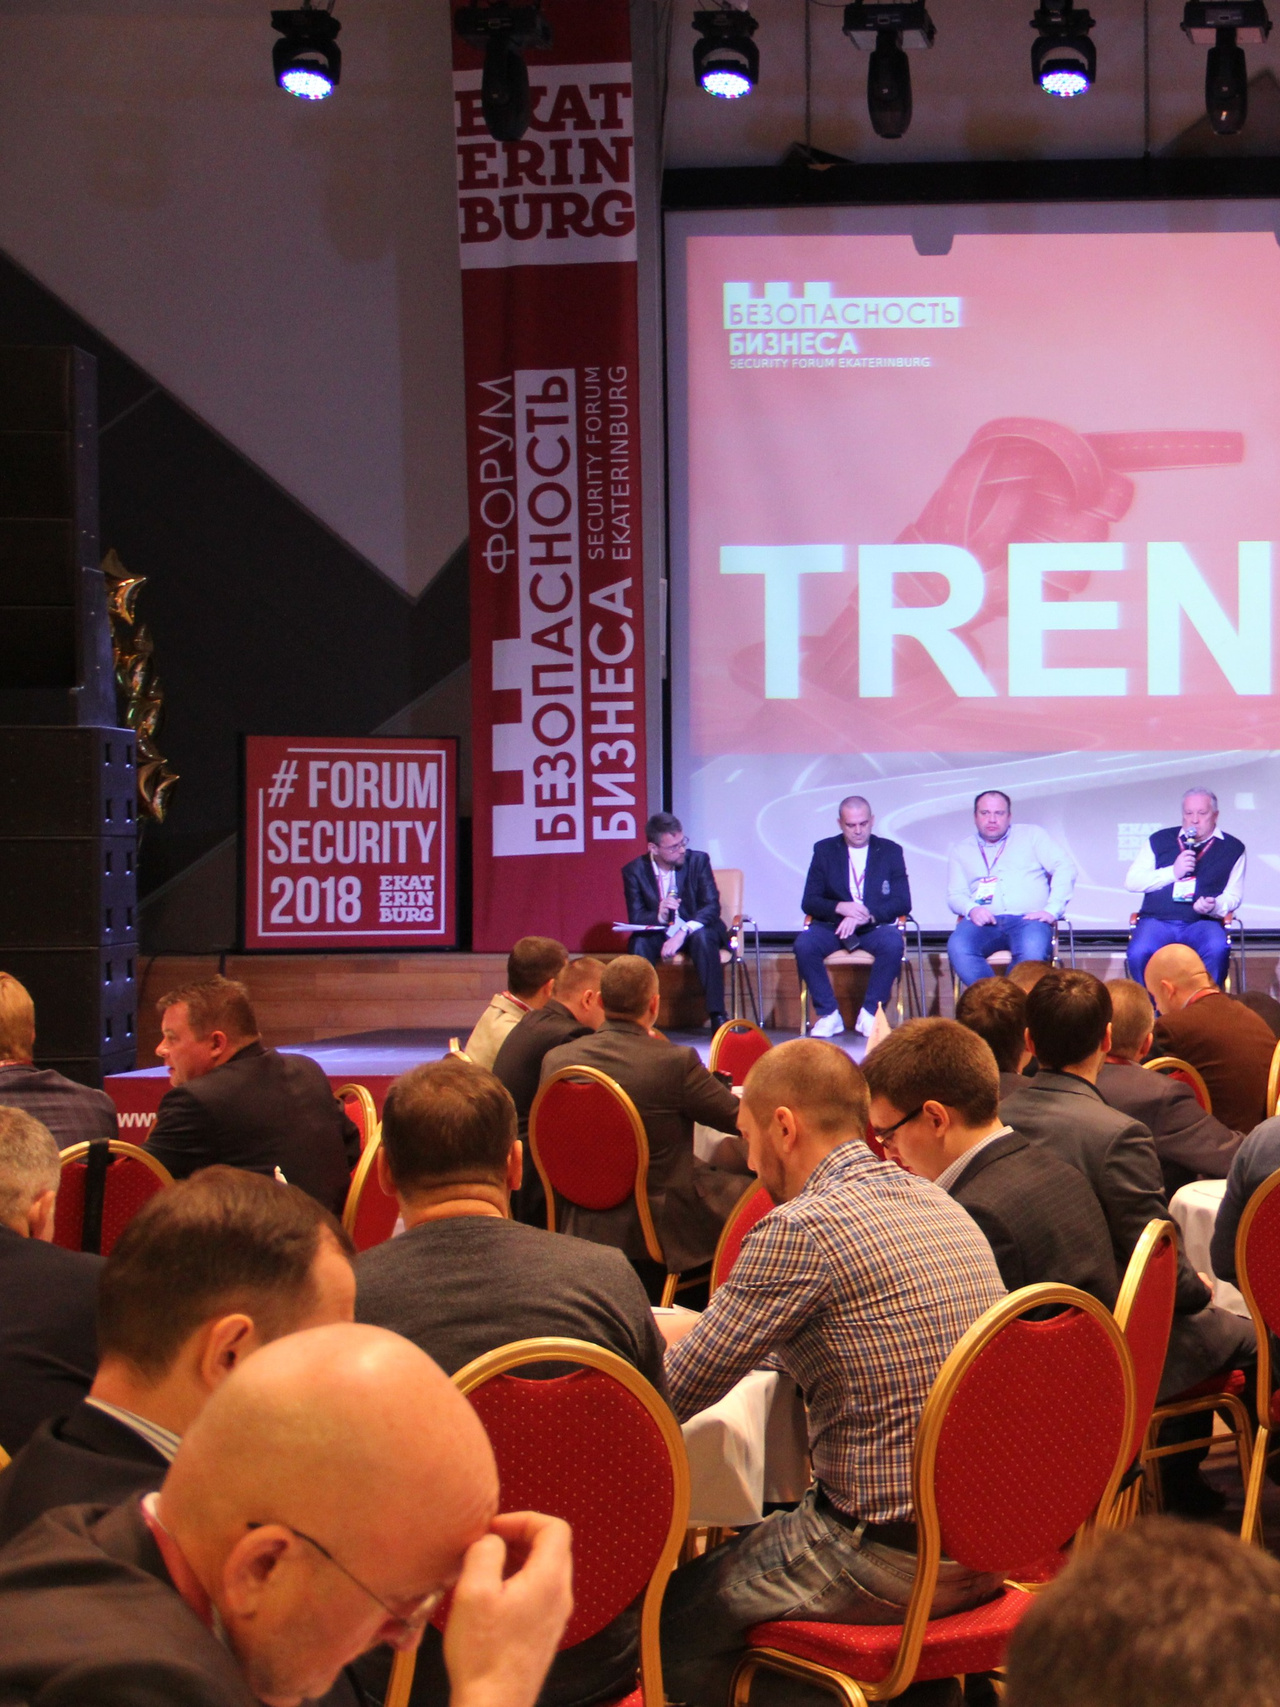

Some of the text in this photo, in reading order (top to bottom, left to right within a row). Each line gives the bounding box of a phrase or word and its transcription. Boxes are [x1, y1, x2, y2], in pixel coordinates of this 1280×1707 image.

[456, 136, 634, 190] ERIN
[459, 189, 636, 244] BURG
[728, 302, 956, 326] БЕЗОПАСНОСТЬ
[728, 332, 859, 356] БИЗНЕСА
[729, 357, 931, 369] SECURITY FORUM EKATERINBURG
[478, 375, 516, 574] ФОРУМ
[584, 366, 605, 560] SECURITY FORUM
[607, 365, 632, 561] EKATERINBURG
[525, 375, 578, 842] БЕЗОПАСНОСТЬ
[588, 577, 637, 840] БИЗНЕСА
[267, 819, 438, 865] SECURITY
[269, 875, 363, 924] 2018
[379, 875, 435, 891] EKAT
[379, 891, 435, 907] ERIN
[379, 907, 435, 923] BURG
